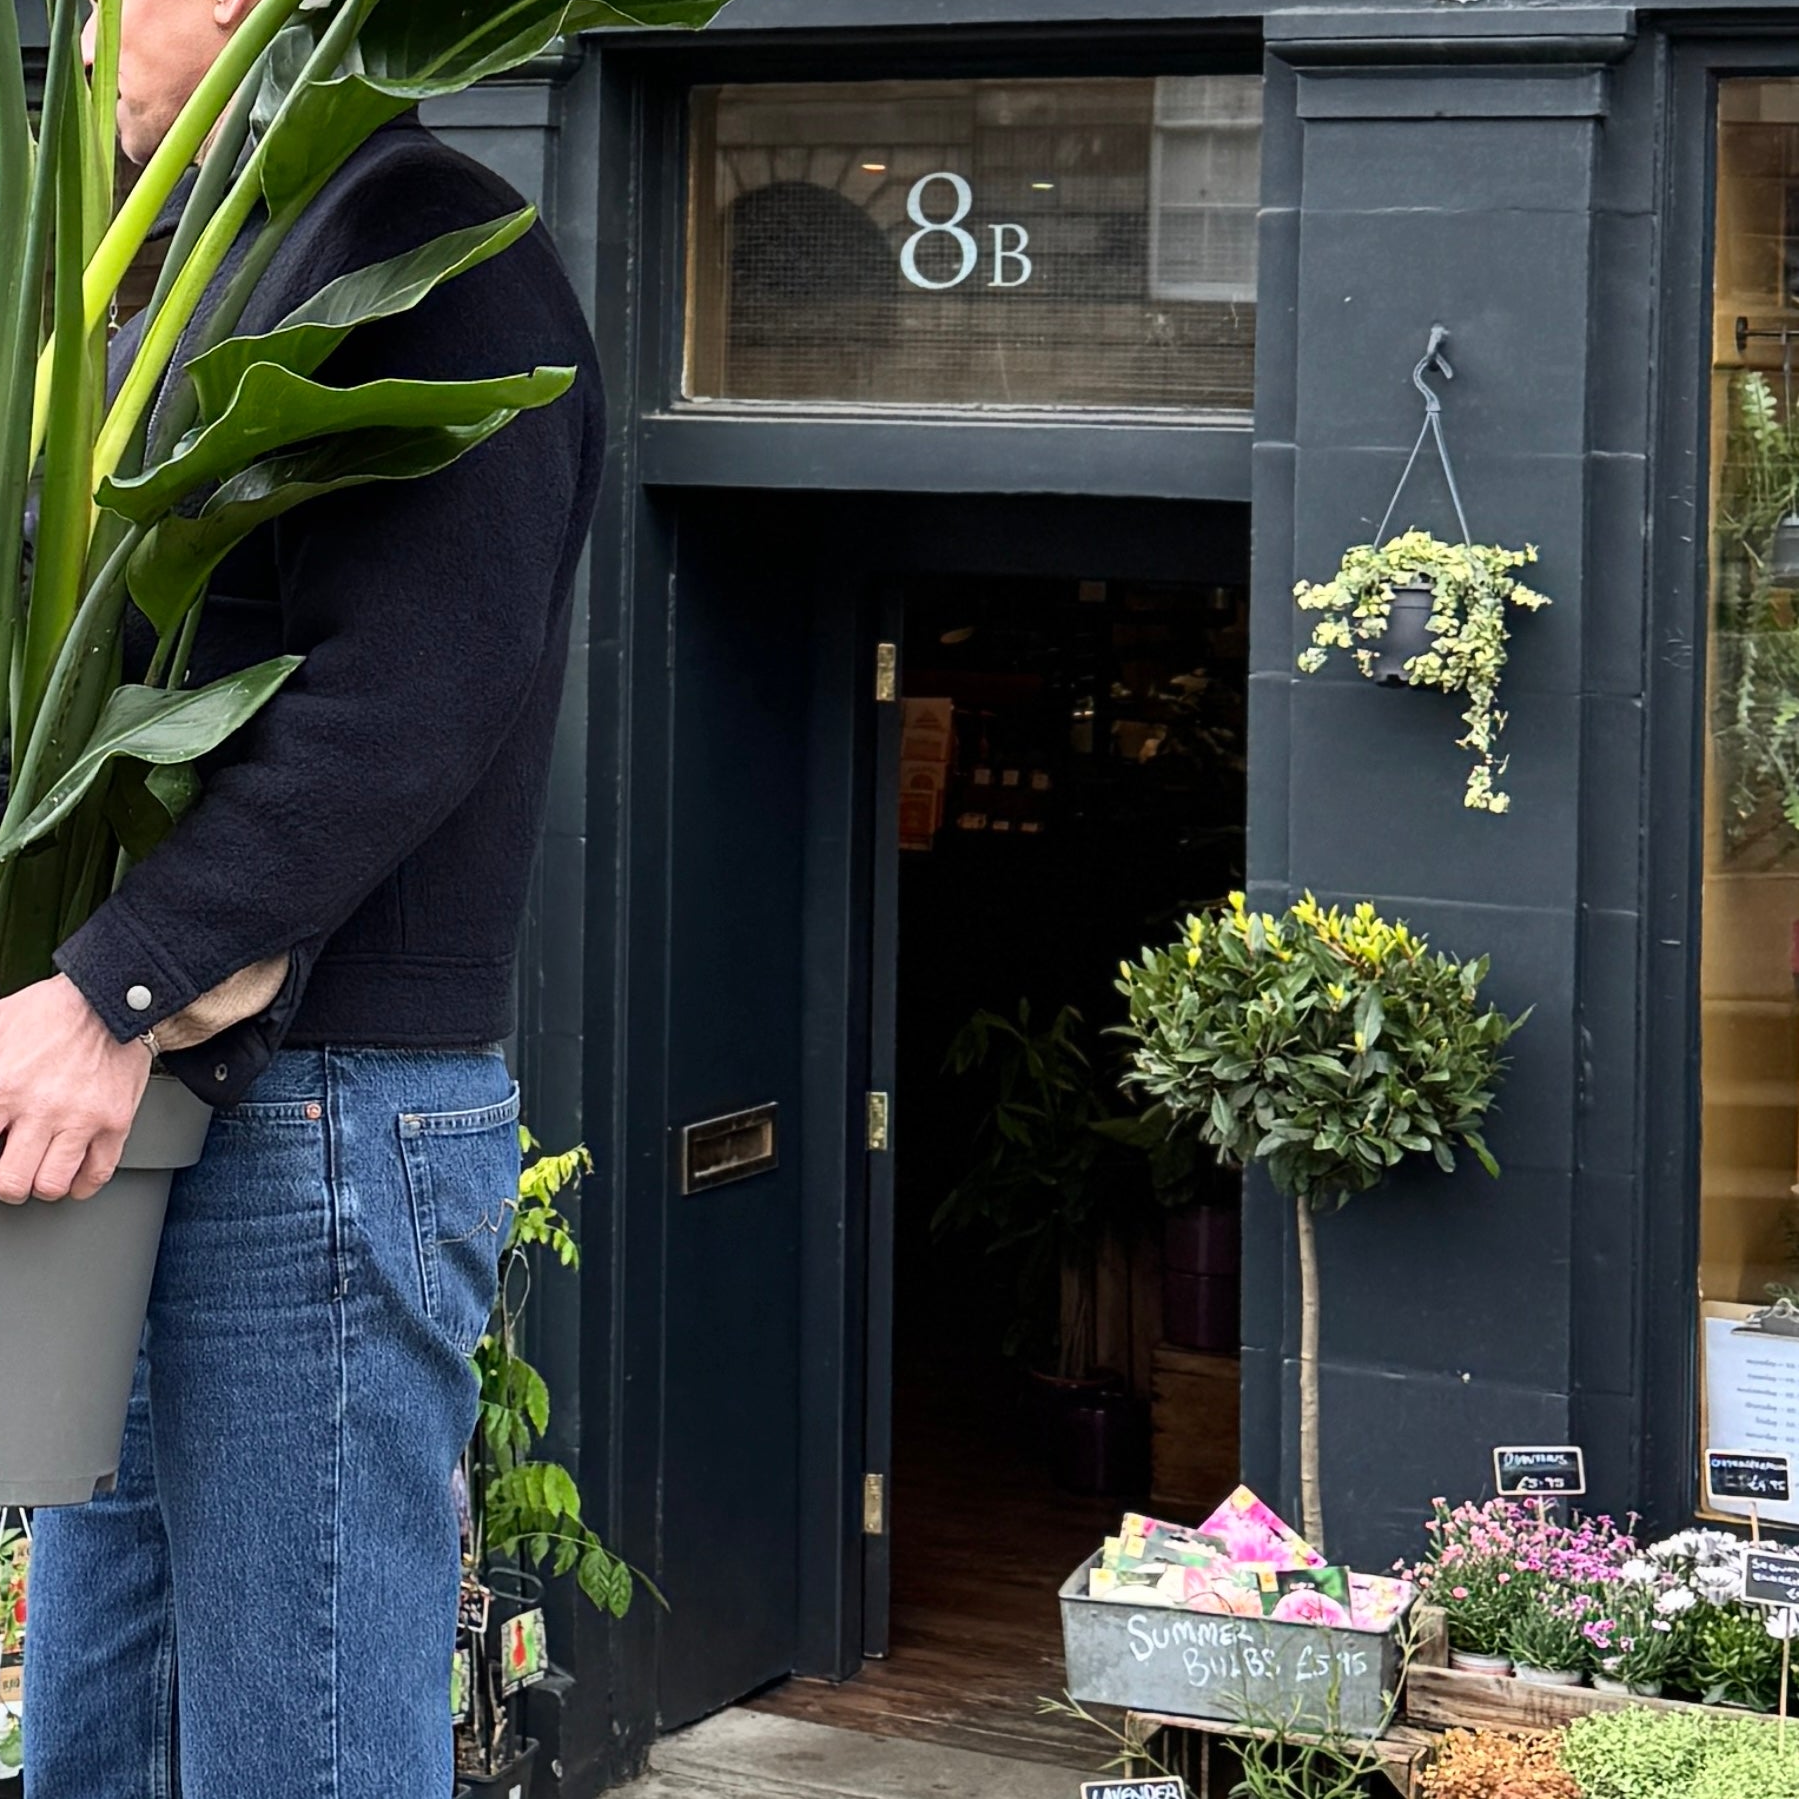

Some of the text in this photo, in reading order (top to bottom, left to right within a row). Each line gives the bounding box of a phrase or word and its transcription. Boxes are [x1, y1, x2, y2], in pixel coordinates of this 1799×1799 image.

[900, 172, 1032, 289] 8B
[1127, 1615, 1253, 1661] SUMMER
[1183, 1648, 1281, 1687] BULBS
